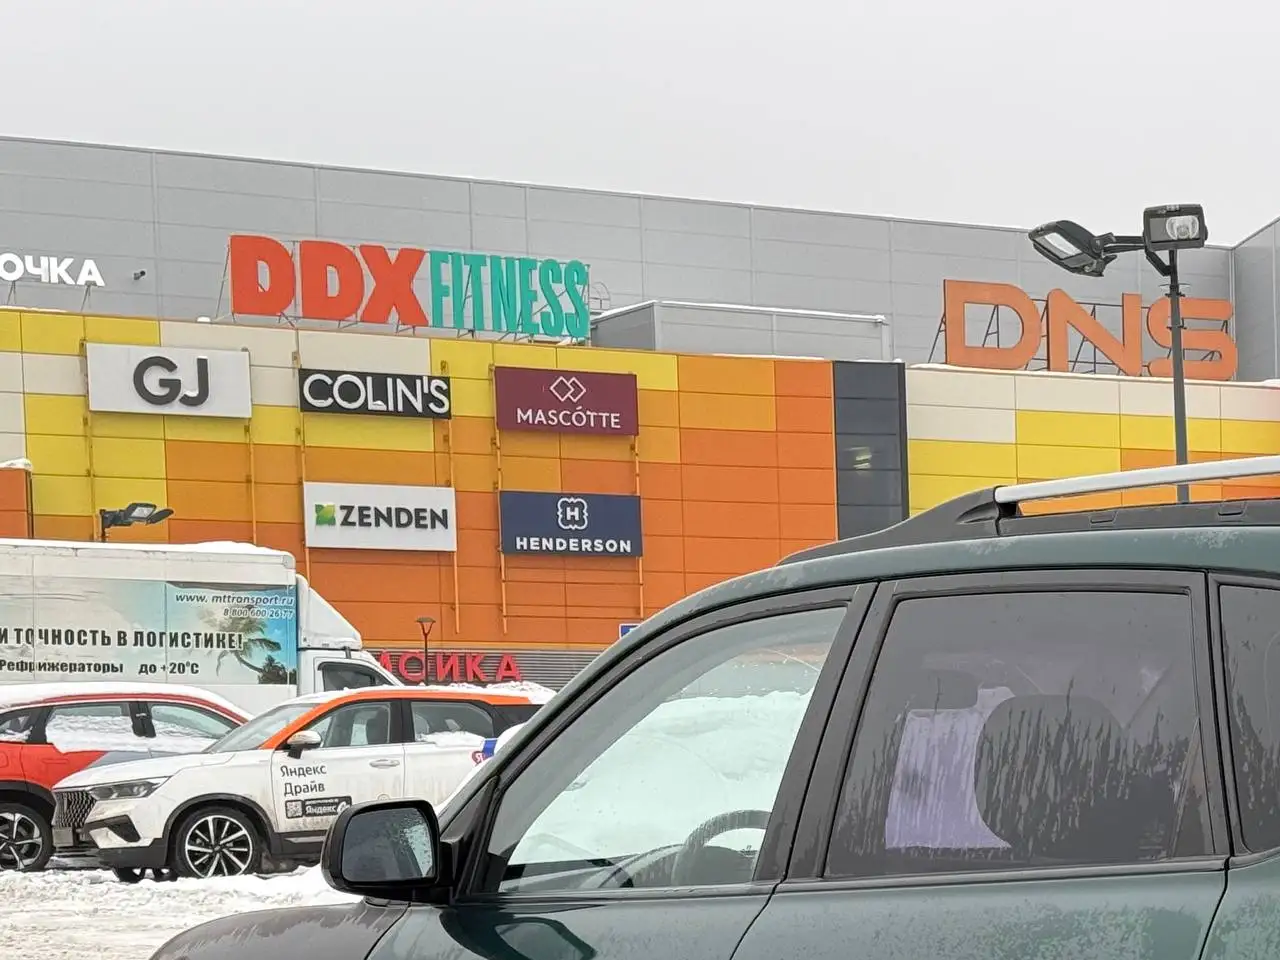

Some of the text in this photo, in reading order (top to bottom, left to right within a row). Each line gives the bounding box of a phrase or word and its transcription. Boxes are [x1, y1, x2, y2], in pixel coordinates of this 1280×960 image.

[0, 253, 105, 287] ОЧКА
[230, 234, 590, 338] DDX FITNESS
[943, 279, 1238, 381] DNS
[133, 355, 209, 406] GJ
[303, 373, 450, 416] COLIN'S
[340, 503, 448, 530] ZENDEN
[515, 536, 632, 553] HENDERSON
[13, 628, 112, 648] ТОЧНОСТЬ
[117, 630, 128, 647] В
[133, 630, 243, 649] ЛОГИСТИКЕ!
[0, 659, 124, 674] Рефрижераторы
[138, 663, 157, 675] до
[280, 765, 327, 777] Яндекс
[284, 780, 325, 796] Драйв
